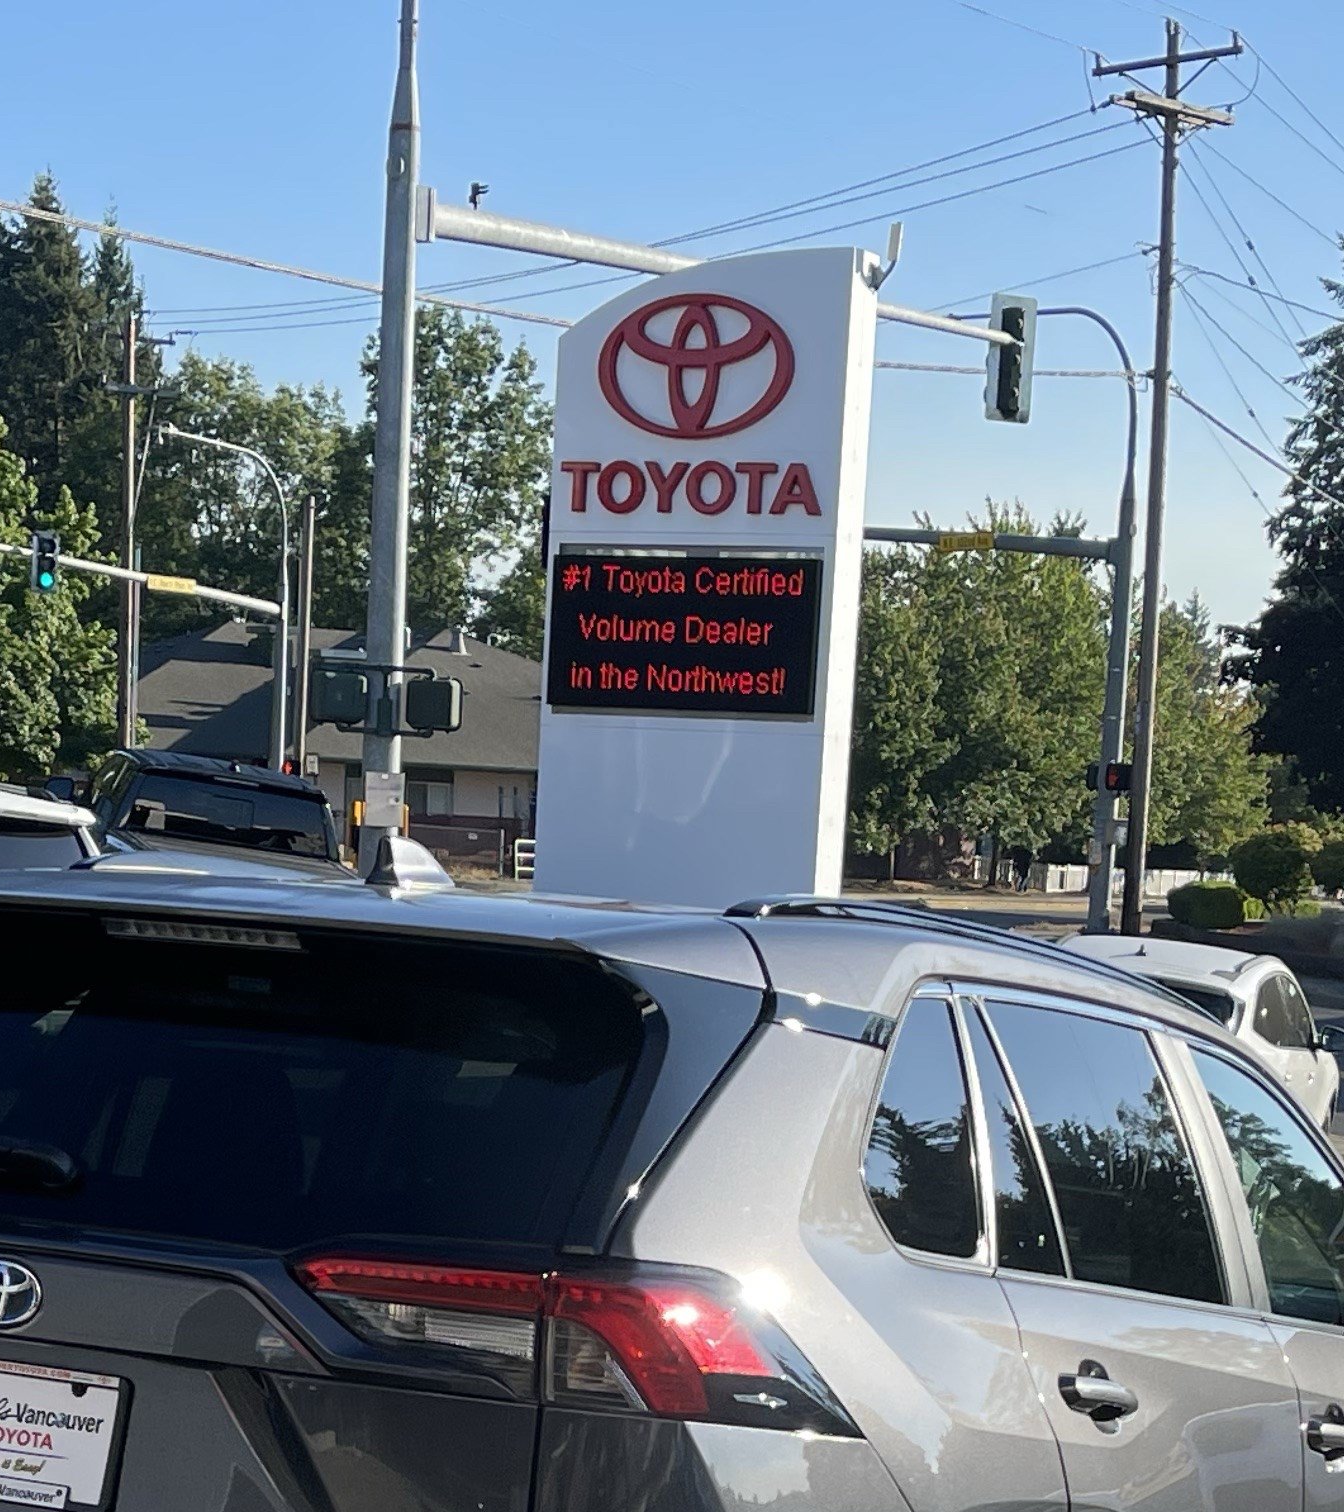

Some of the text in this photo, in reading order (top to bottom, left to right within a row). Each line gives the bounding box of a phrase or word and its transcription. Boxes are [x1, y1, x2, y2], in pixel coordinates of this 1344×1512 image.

[560, 460, 822, 517] TOYOTA
[562, 564, 804, 598] #1 Toyota Certified
[578, 612, 774, 646] Volume Dealer
[571, 660, 788, 696] in the Northwest!
